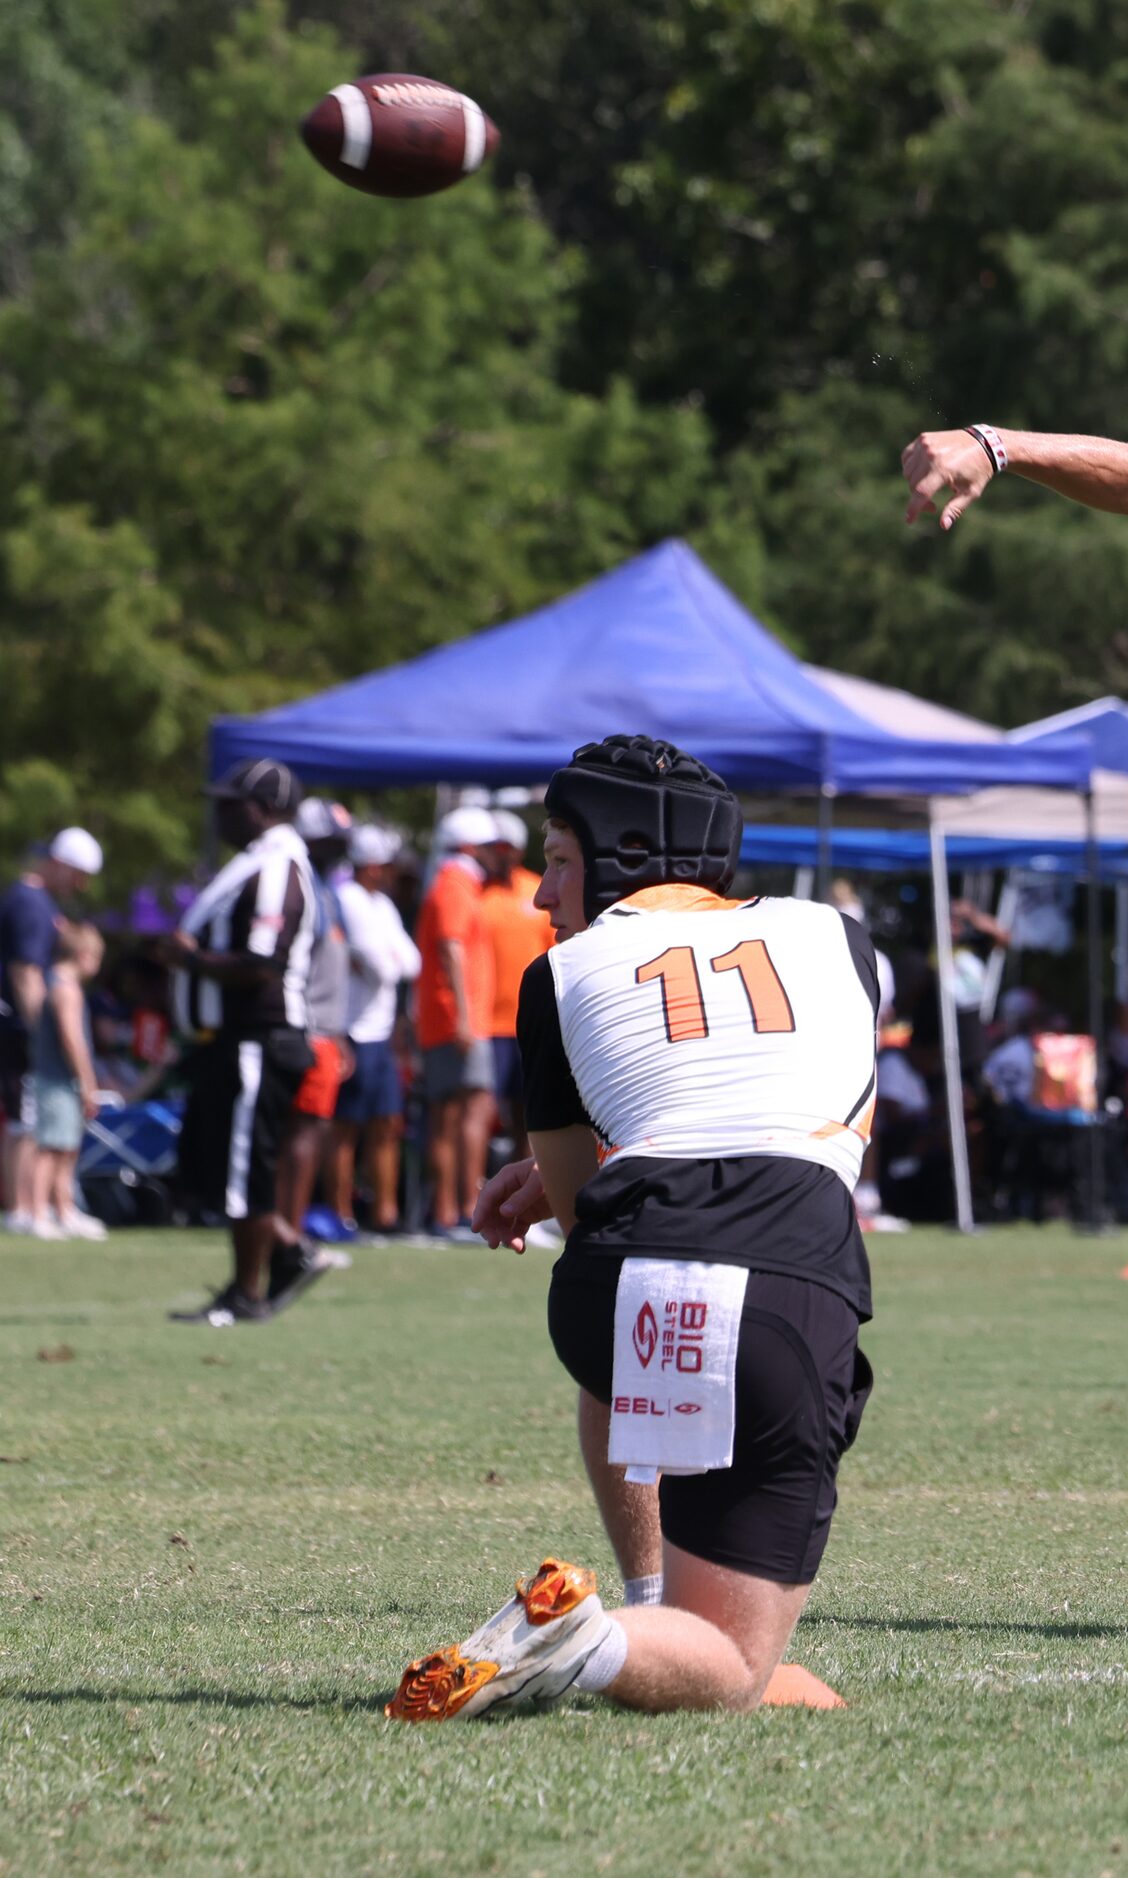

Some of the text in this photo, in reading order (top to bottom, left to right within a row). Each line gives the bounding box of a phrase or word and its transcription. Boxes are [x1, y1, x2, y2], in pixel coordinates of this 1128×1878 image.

[635, 939, 796, 1043] 11
[661, 1300, 678, 1372] STEEL
[676, 1302, 708, 1374] BIO
[613, 1397, 665, 1416] EEL
